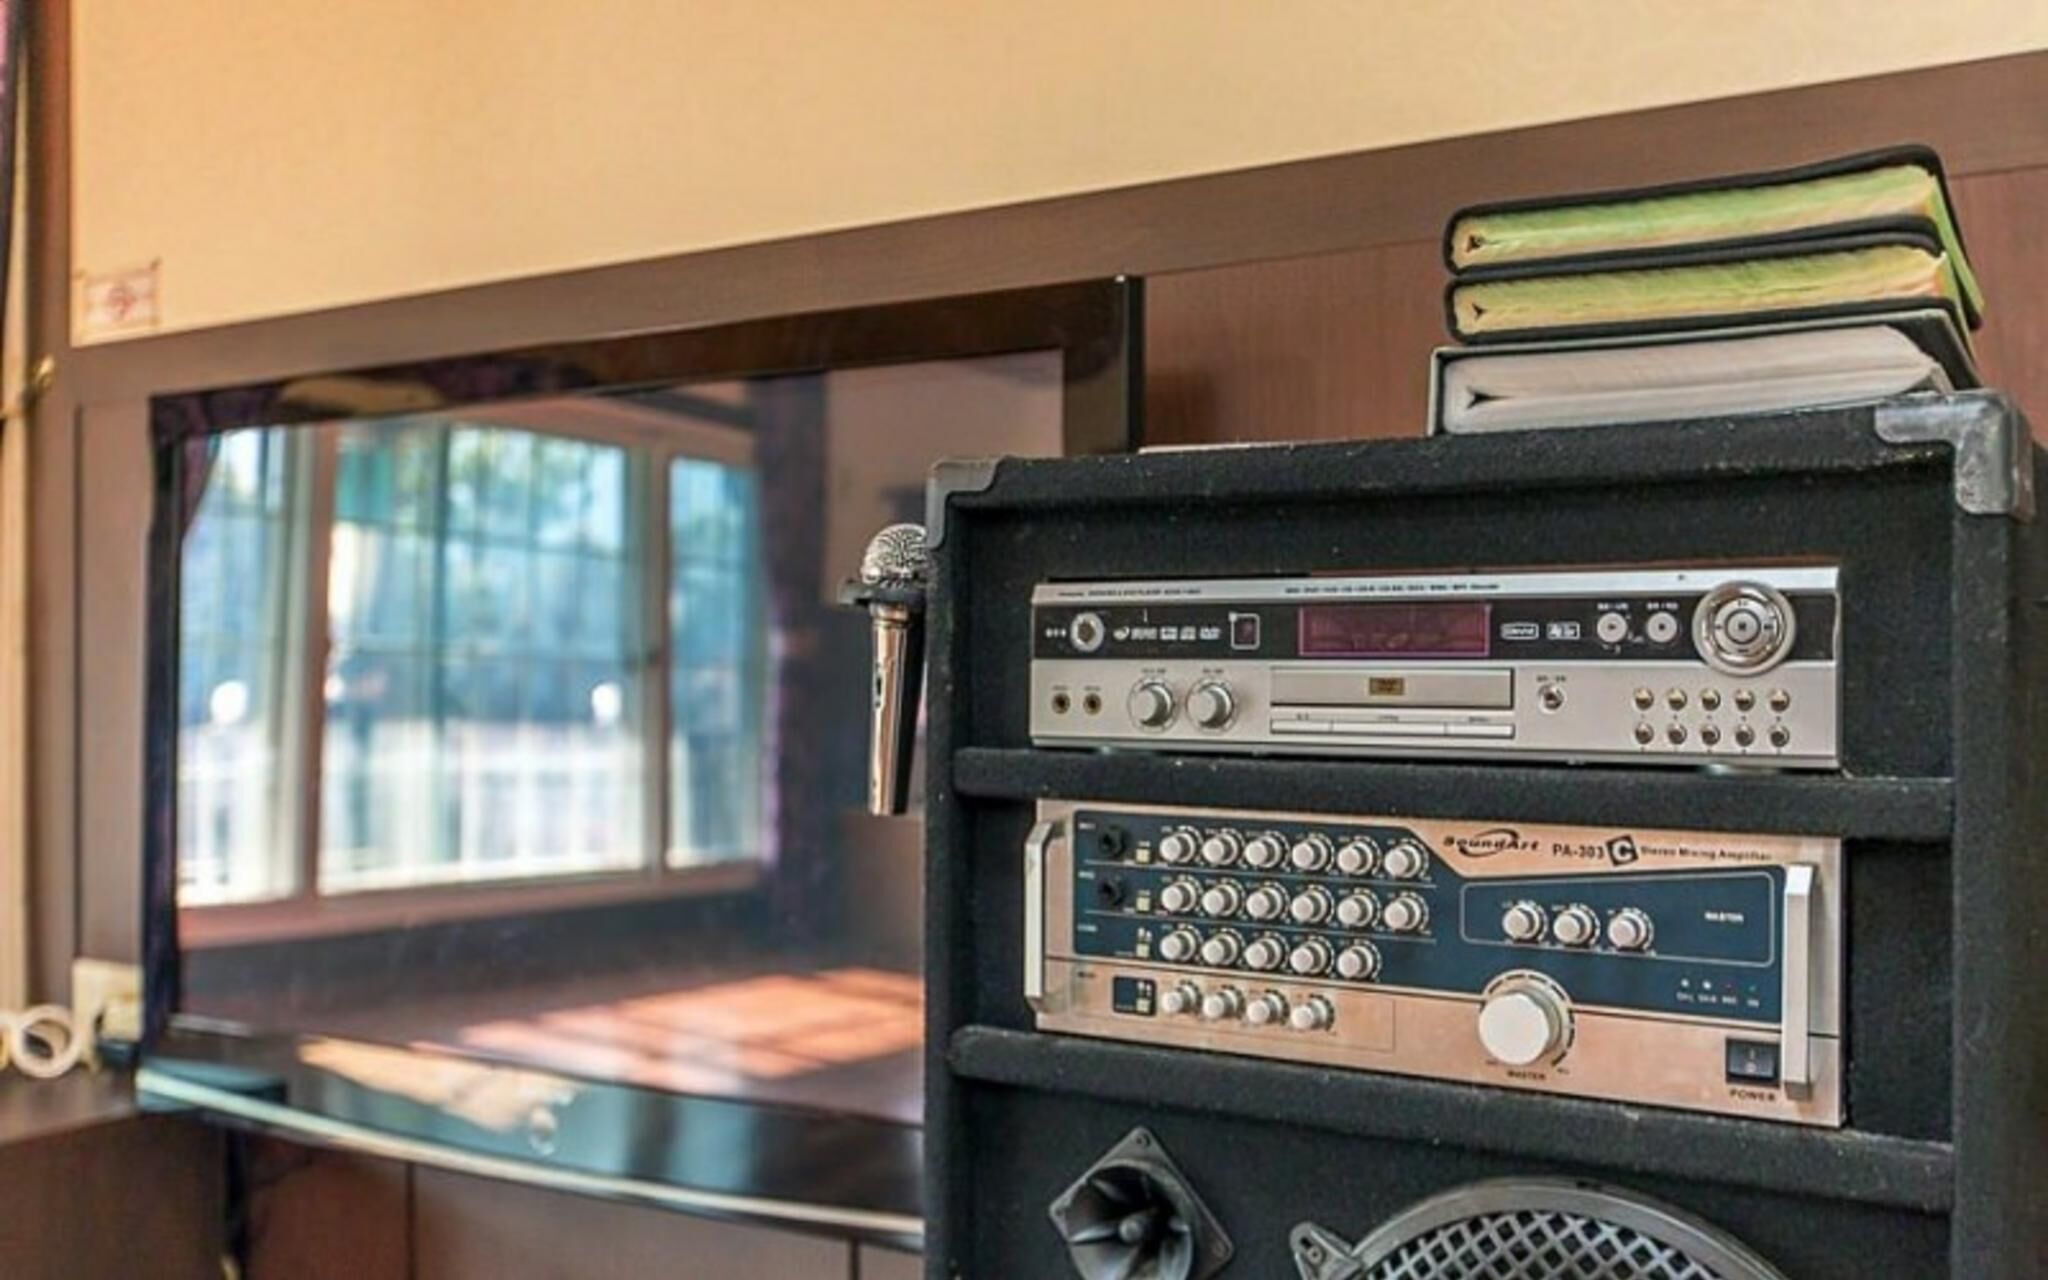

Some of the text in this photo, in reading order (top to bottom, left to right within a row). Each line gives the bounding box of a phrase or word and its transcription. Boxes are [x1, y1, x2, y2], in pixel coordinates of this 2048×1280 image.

[1640, 846, 1677, 856] Stereo
[1679, 847, 1716, 860] Mixing
[1718, 848, 1772, 861] Amplifier
[1729, 1089, 1776, 1102] POWER
